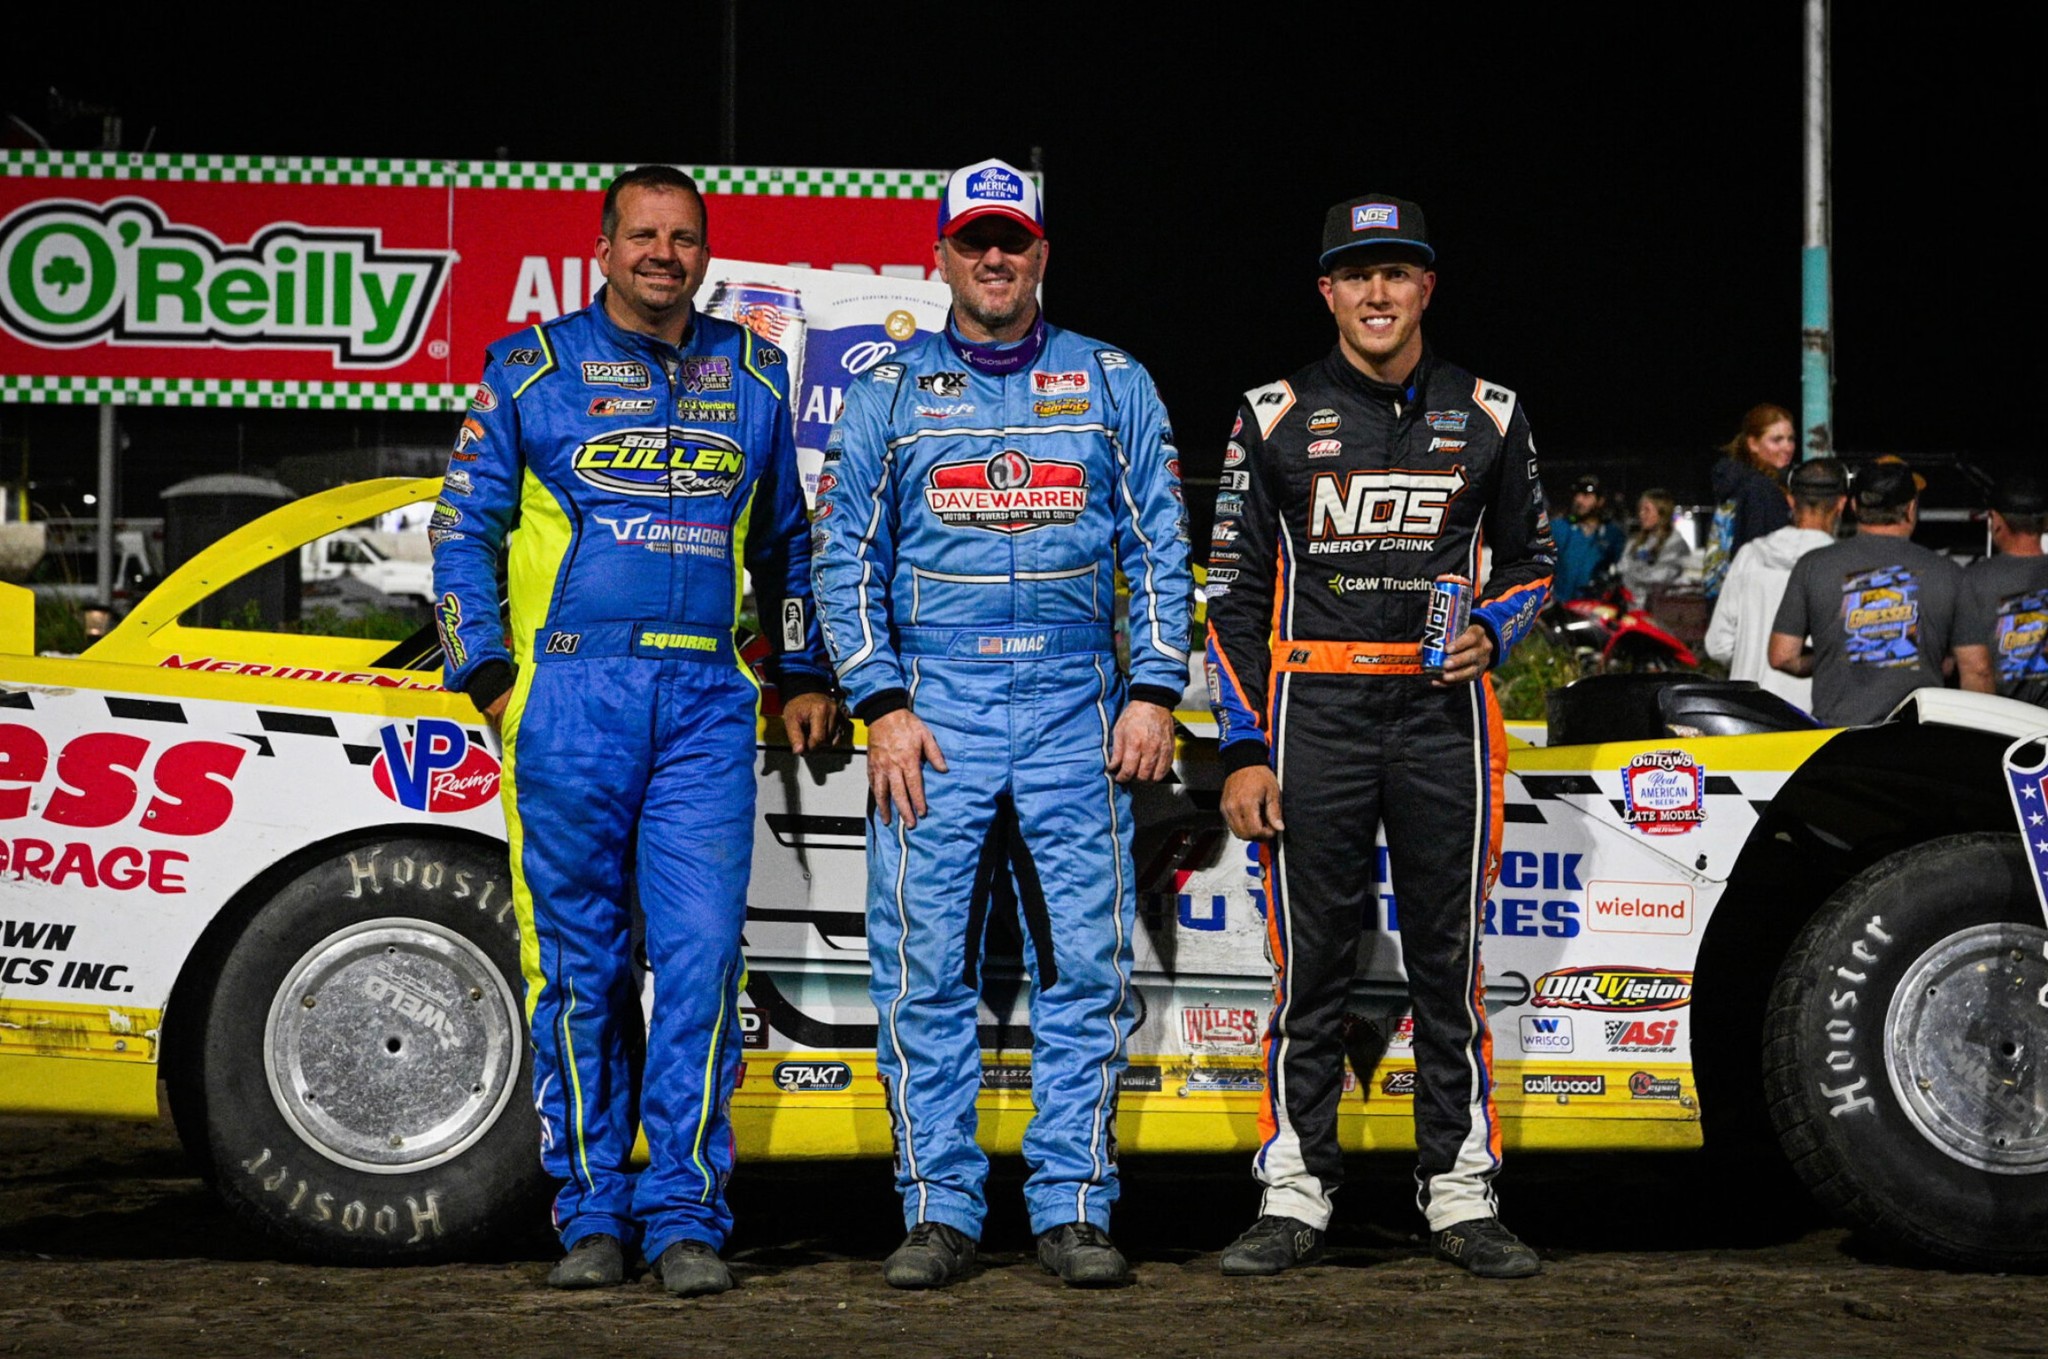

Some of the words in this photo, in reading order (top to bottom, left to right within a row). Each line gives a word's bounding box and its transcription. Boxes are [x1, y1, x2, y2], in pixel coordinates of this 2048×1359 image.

[972, 180, 1018, 195] AMERICAN
[1356, 207, 1393, 224] NOS
[8, 219, 416, 345] O'Reilly
[585, 365, 646, 377] HOKER
[917, 372, 967, 393] FOX
[622, 434, 667, 449] BOB
[575, 443, 744, 474] CULLEN
[658, 470, 739, 499] Racing
[1312, 471, 1466, 537] NOS
[943, 512, 971, 521] MOTORS
[1033, 511, 1050, 519] AUTO
[1053, 511, 1075, 519] CENTER
[640, 521, 727, 545] LONGHORN
[674, 542, 726, 559] DYNAMICS
[1309, 540, 1375, 554] ENERGY
[1380, 539, 1435, 552] DRINK
[1345, 577, 1380, 591] C&W
[1382, 576, 1432, 591] Truckin
[1423, 589, 1452, 651] NOS
[546, 631, 580, 653] K1
[640, 632, 718, 652] SQUIRREL
[1006, 635, 1045, 652] TMAC
[380, 717, 466, 812] VP
[1631, 751, 1693, 770] OUTLAWS
[433, 770, 501, 800] Racing
[1648, 772, 1678, 787] Real
[1641, 787, 1688, 798] AMERICAN
[1624, 811, 1656, 823] LATE
[1660, 809, 1707, 822] MODELS
[0, 838, 190, 894] RAGE
[1596, 898, 1685, 919] wieland
[58, 961, 134, 993] INC.
[1540, 972, 1692, 1005] DIRTVision
[1185, 1009, 1257, 1044] WILES
[1820, 914, 1892, 1120] Hoosier
[1524, 1036, 1570, 1046] WRISCO
[779, 1066, 844, 1083] STAKT
[1385, 1073, 1415, 1090] XS
